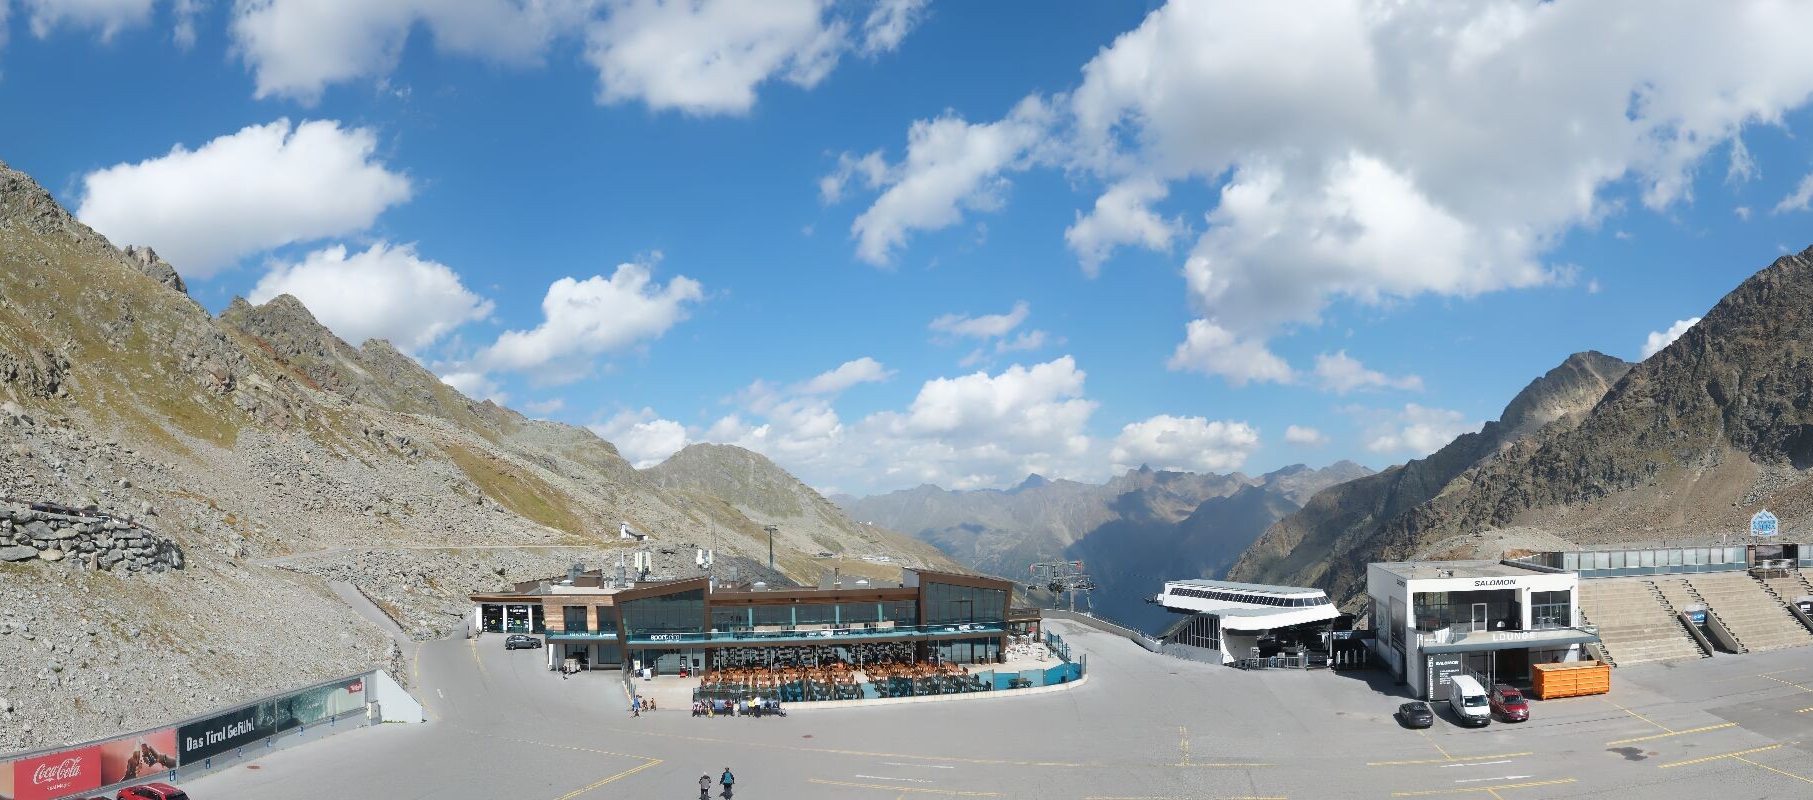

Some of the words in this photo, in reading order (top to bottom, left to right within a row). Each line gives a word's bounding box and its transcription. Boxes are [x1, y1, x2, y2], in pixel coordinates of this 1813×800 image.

[1474, 579, 1516, 587] SALOMON
[1492, 631, 1536, 641] LOUNGE
[186, 736, 204, 751] Das
[205, 726, 226, 746] Tirol
[228, 717, 255, 739] Gefühl
[33, 756, 82, 784] Coca-Cola
